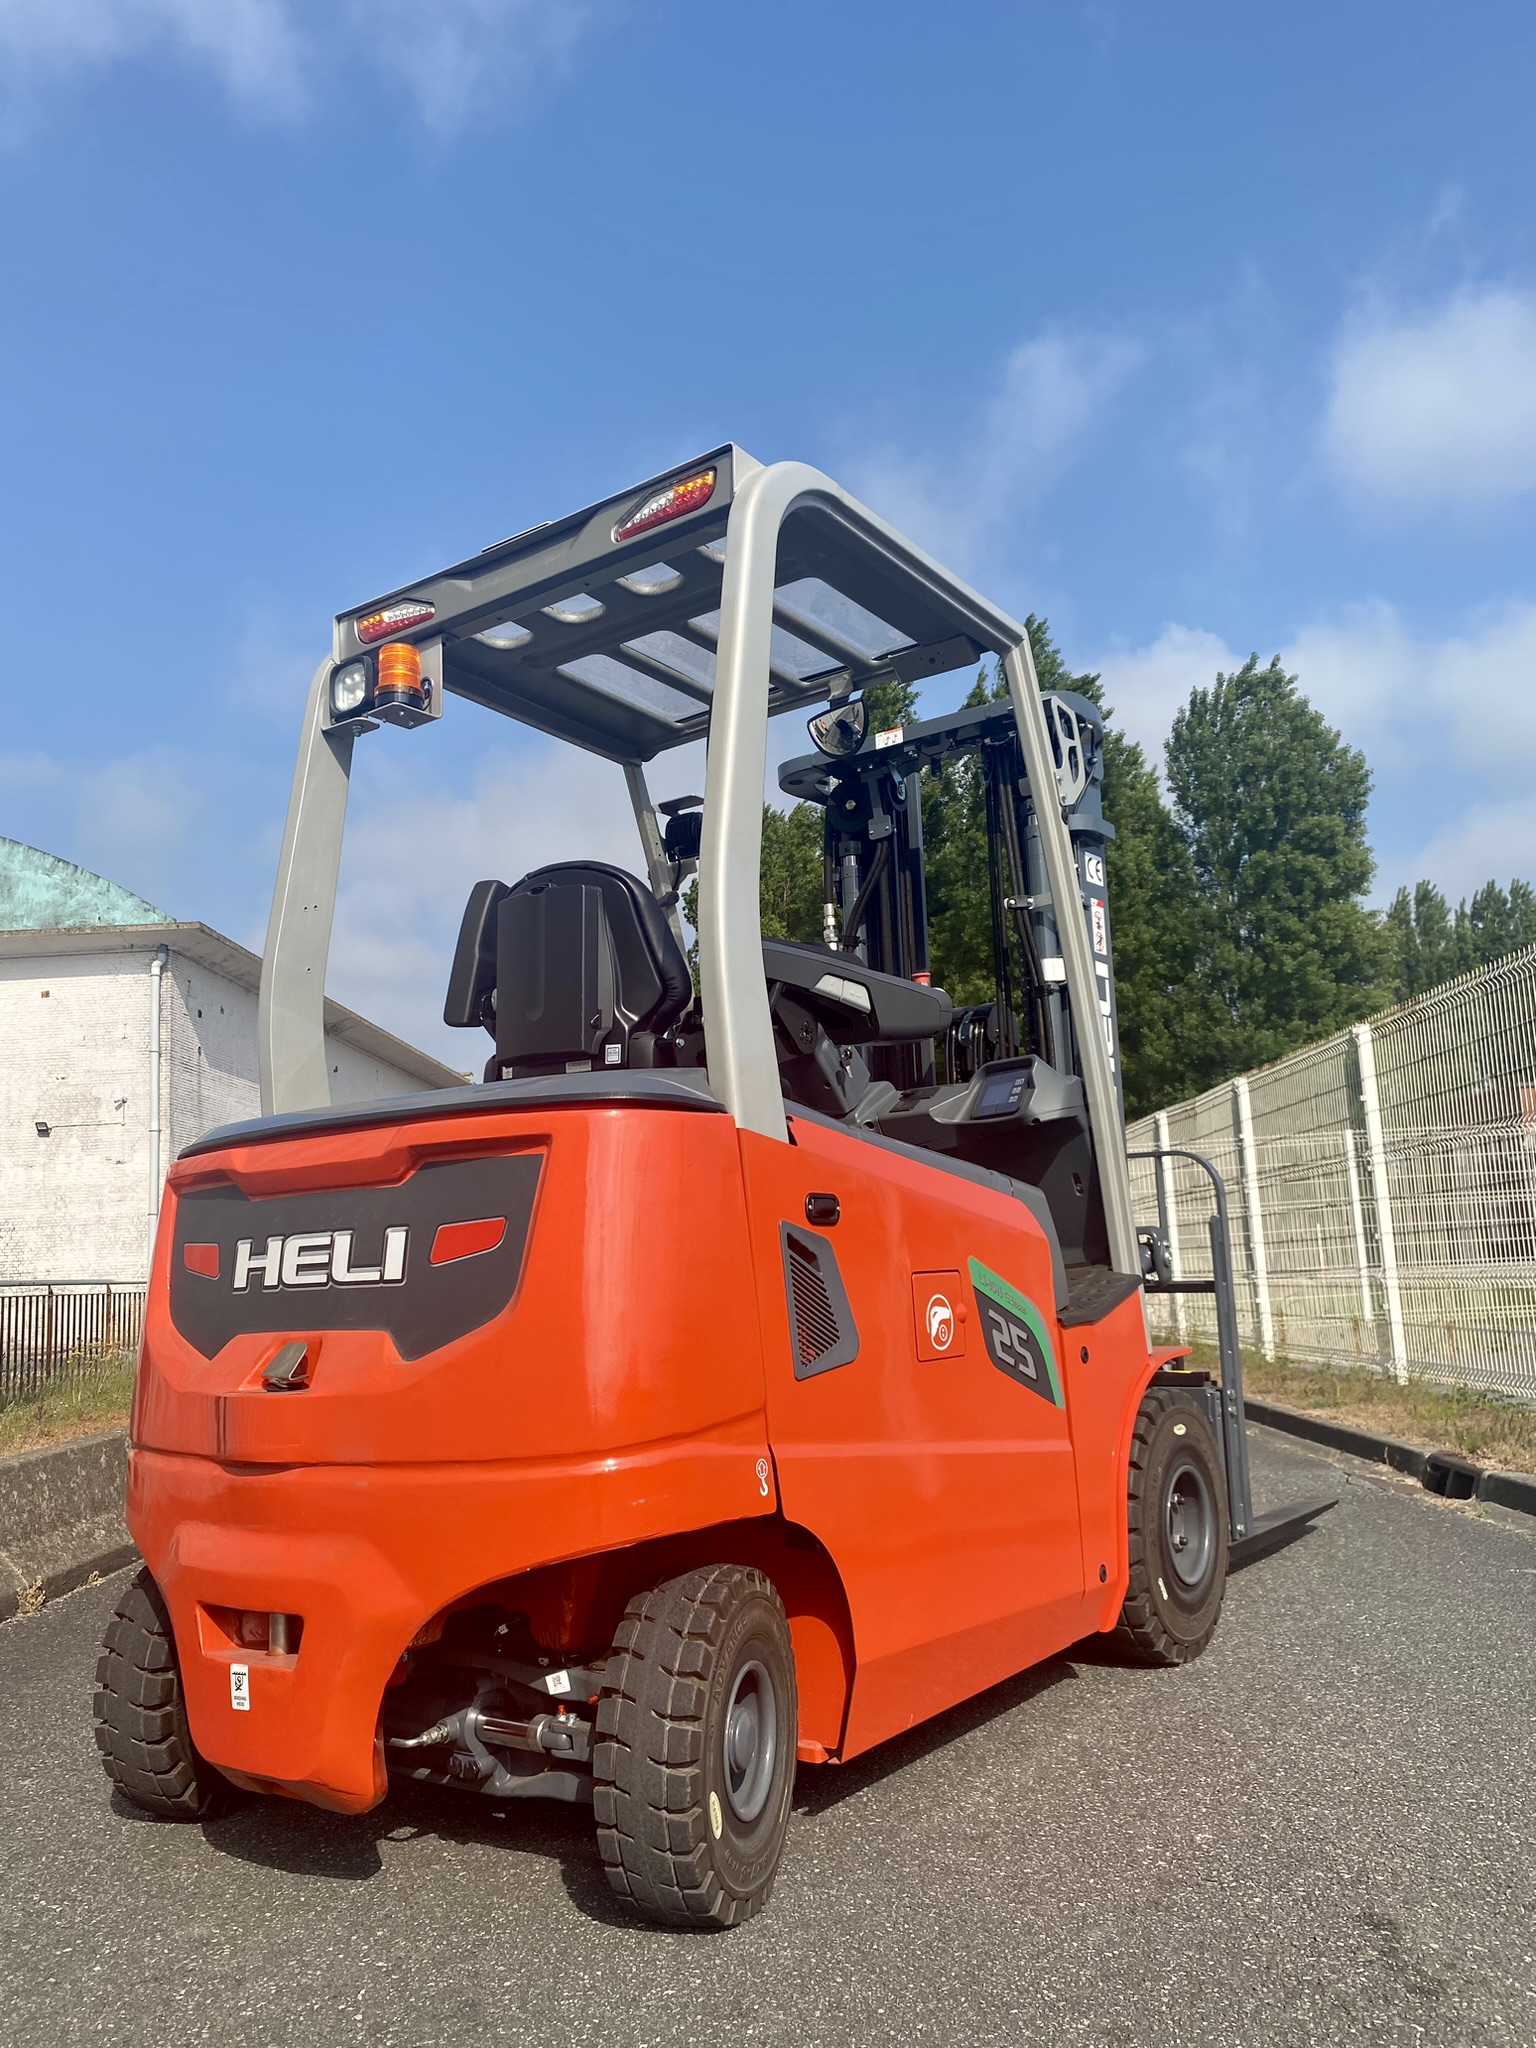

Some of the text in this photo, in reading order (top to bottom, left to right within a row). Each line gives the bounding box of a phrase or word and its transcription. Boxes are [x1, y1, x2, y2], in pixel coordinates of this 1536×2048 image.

[1094, 960, 1118, 1102] ELI
[233, 1227, 408, 1291] HELI
[988, 1309, 1038, 1380] 25
[713, 1611, 747, 1706] ADVANCE
